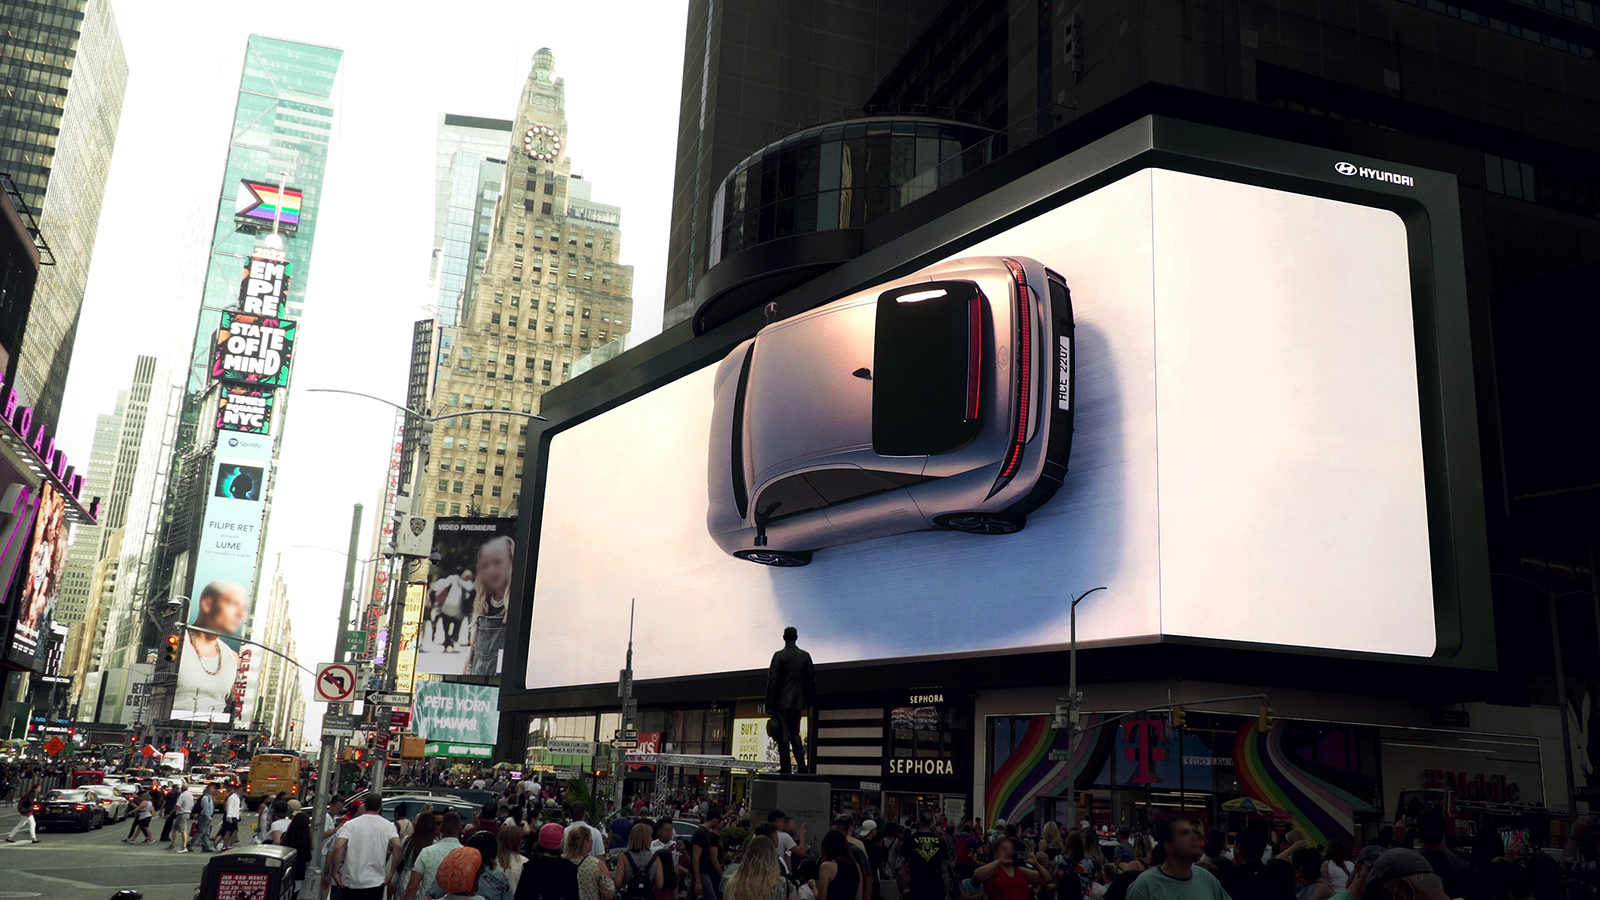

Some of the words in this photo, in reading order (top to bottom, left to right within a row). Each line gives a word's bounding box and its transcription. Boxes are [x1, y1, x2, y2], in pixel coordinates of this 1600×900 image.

[1359, 166, 1414, 187] HYUNDAI
[227, 335, 260, 356] OF
[229, 322, 286, 359] STATE
[223, 349, 281, 376] MIND
[227, 393, 266, 407] TIMES
[226, 403, 265, 414] SQUARE
[223, 411, 264, 428] NYC
[240, 440, 262, 449] Spotify
[209, 520, 236, 531] FILIPE
[237, 523, 255, 532] RET
[438, 523, 459, 531] VIDEO
[460, 524, 497, 532] PREMIERE
[215, 541, 242, 551] LUME
[405, 604, 420, 612] ODAY
[372, 694, 386, 703] ONE
[391, 694, 407, 703] WAY
[424, 695, 454, 710] PETE
[455, 697, 491, 713] YORN
[909, 694, 944, 704] SEPHORA
[433, 716, 477, 731] HAWAII
[740, 723, 753, 735] BUY
[1124, 719, 1165, 783] T
[889, 758, 954, 775] SEPHORA
[1454, 818, 1467, 828] BIG
